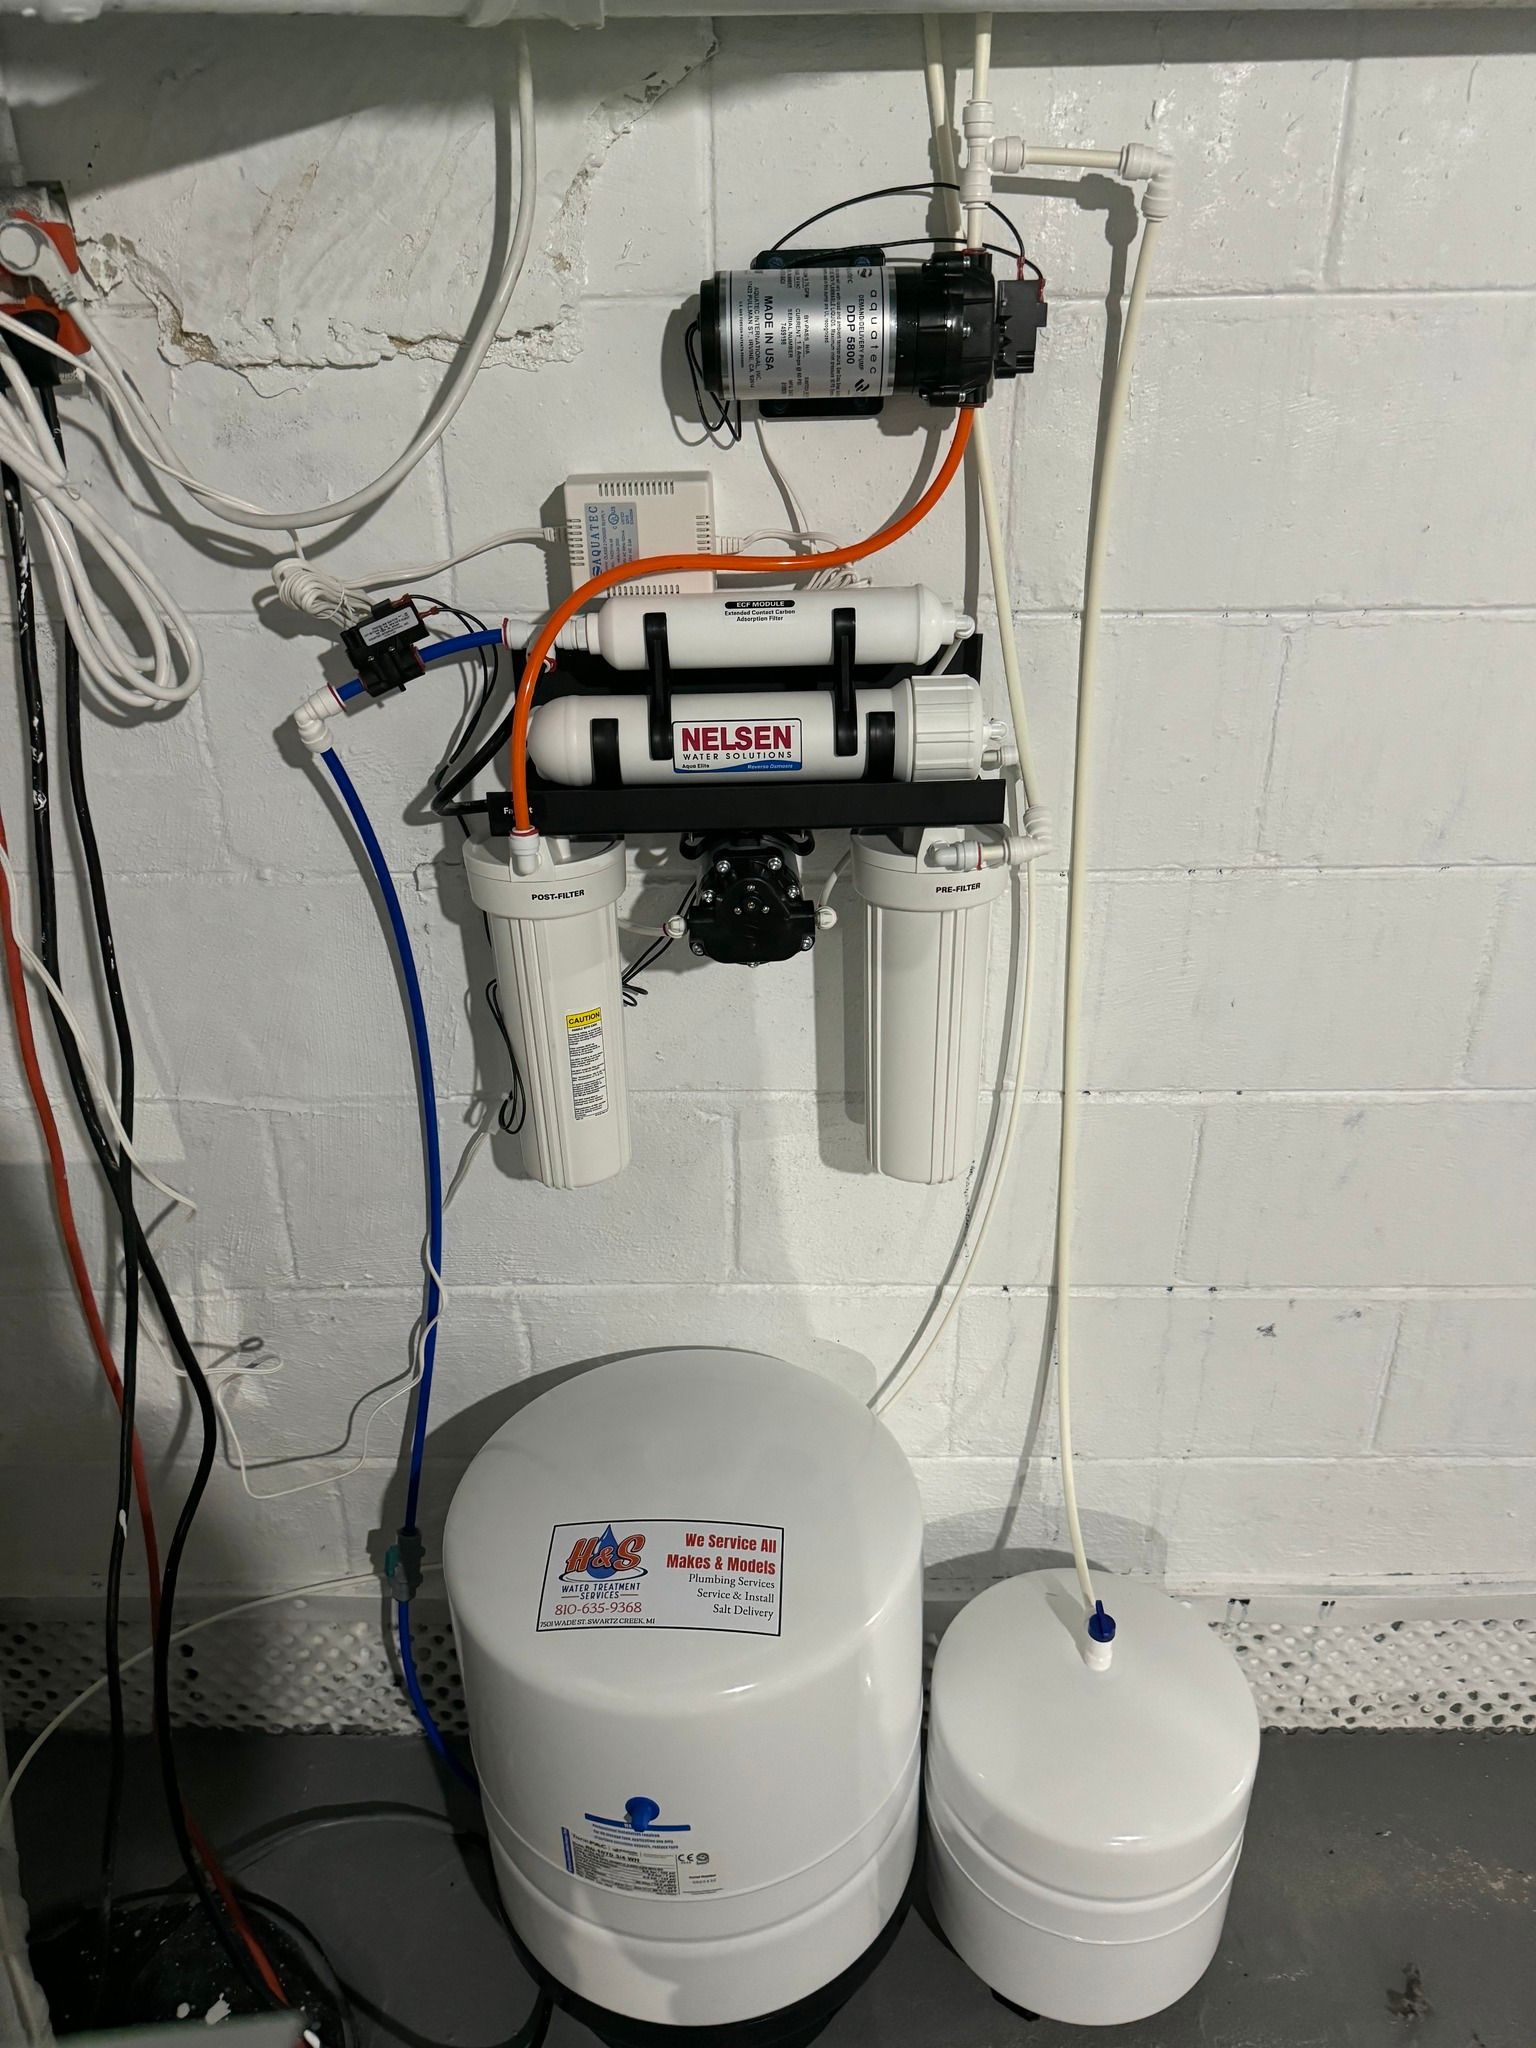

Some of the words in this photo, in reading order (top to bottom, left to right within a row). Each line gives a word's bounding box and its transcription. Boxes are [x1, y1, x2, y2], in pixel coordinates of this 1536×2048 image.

[764, 296, 773, 328] MADE
[846, 305, 855, 331] DDP
[765, 333, 773, 344] IN
[869, 290, 879, 374] aquatec
[846, 337, 855, 364] 5800
[765, 348, 774, 371] USA
[589, 506, 601, 565] AQUATEC
[682, 726, 792, 751] NELSEN
[683, 753, 718, 761] WATER
[726, 752, 792, 760] SOLUTIONS
[503, 806, 534, 815] Fat
[531, 889, 585, 900] POST-FILTER
[936, 882, 981, 893] PRE-FILTER
[569, 1012, 600, 1025] CAUTION
[685, 1533, 704, 1547] We
[708, 1534, 756, 1551] Service
[760, 1539, 776, 1553] All
[565, 1534, 646, 1573] H&S
[666, 1554, 710, 1569] Makes
[714, 1556, 722, 1570] &
[727, 1557, 776, 1575] Models
[562, 1584, 589, 1593] WATER
[594, 1583, 640, 1591] TREATMENT
[688, 1573, 736, 1588] Plumbing
[738, 1577, 775, 1589] Services
[580, 1591, 619, 1600] SERVICES
[697, 1588, 731, 1599] Service
[733, 1591, 742, 1600] &
[745, 1592, 774, 1603] Install
[555, 1602, 642, 1615] 810-635-9368
[713, 1604, 731, 1614] Salt
[734, 1605, 774, 1621] Delivery
